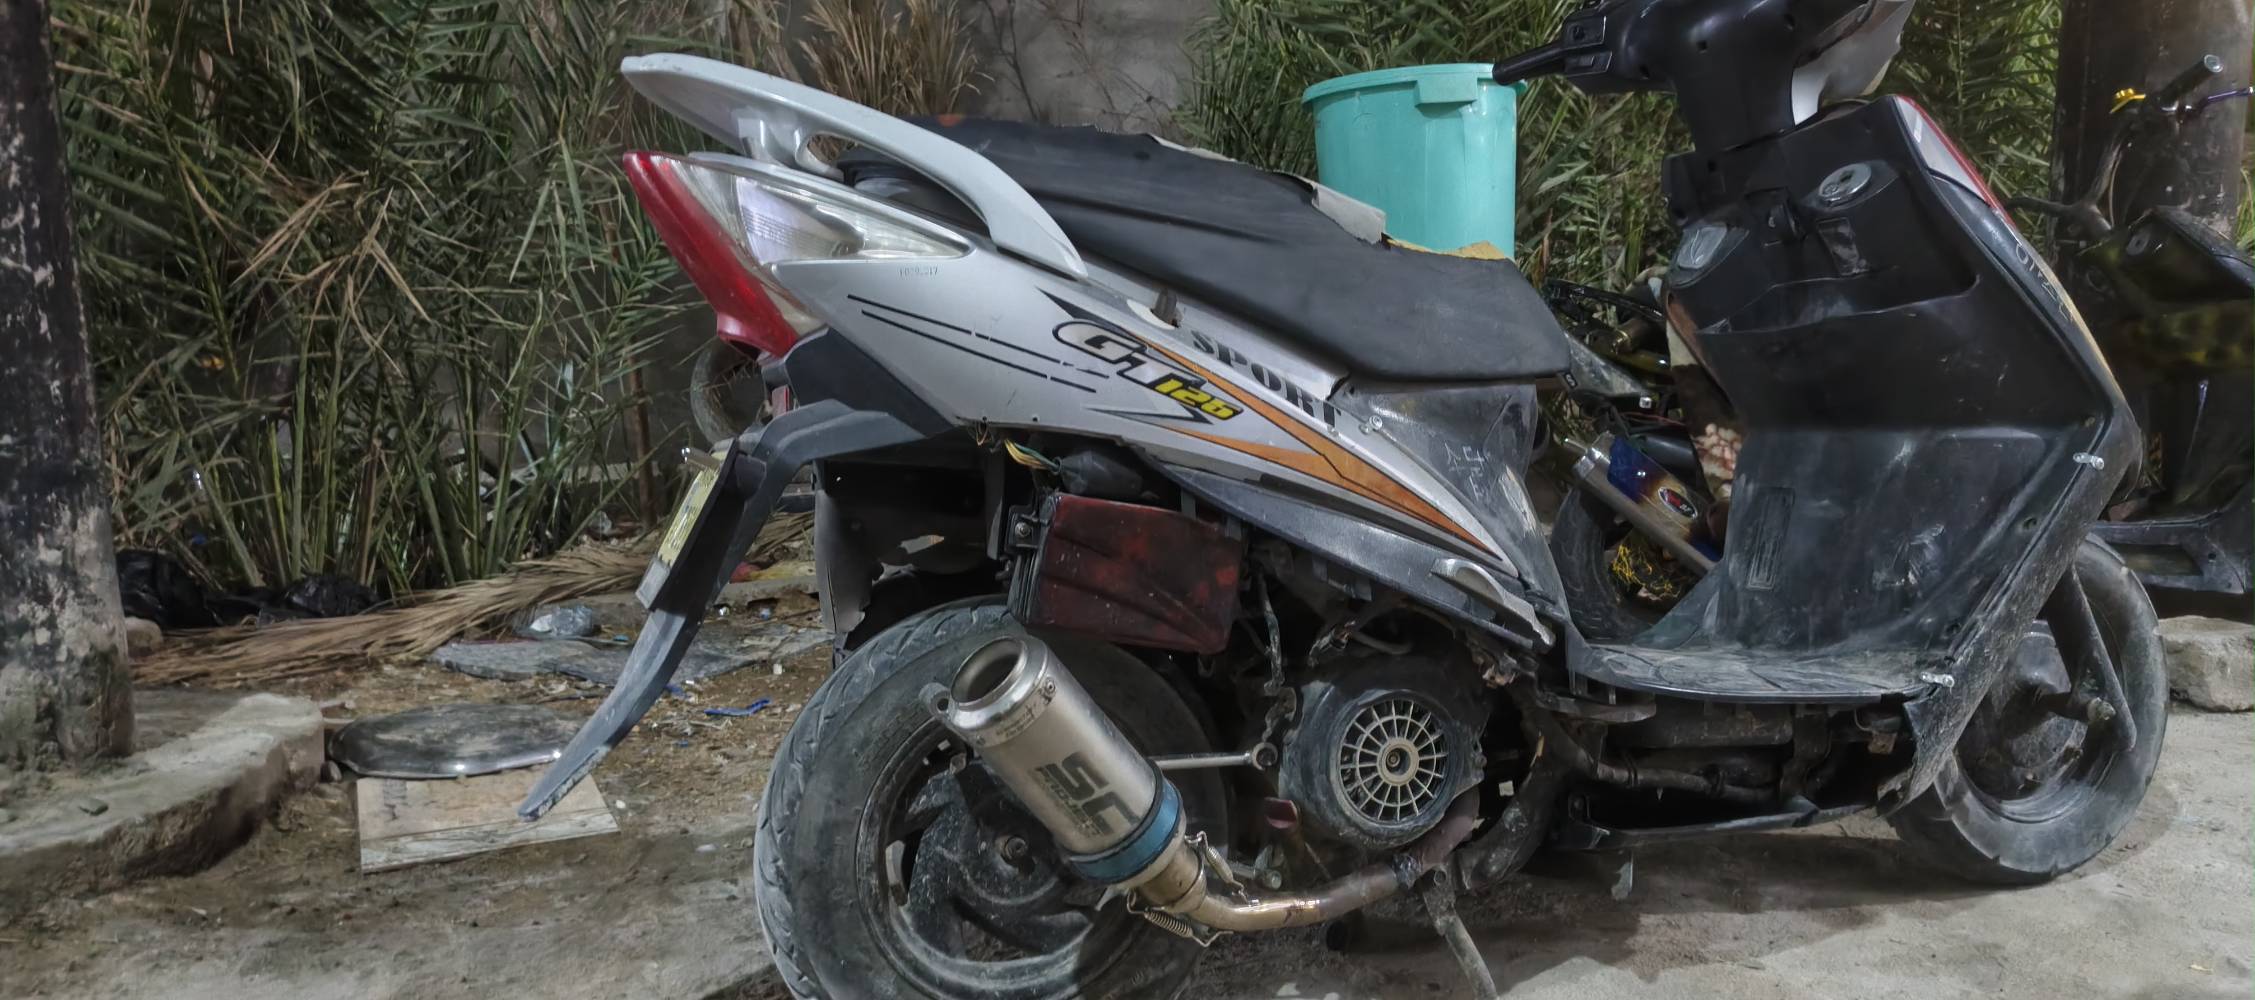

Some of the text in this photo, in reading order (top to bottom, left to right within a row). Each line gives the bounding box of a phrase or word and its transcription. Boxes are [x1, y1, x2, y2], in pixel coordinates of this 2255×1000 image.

[1053, 318, 1208, 388] GT
[1190, 330, 1342, 427] SPORT
[1045, 752, 1141, 836] SC
